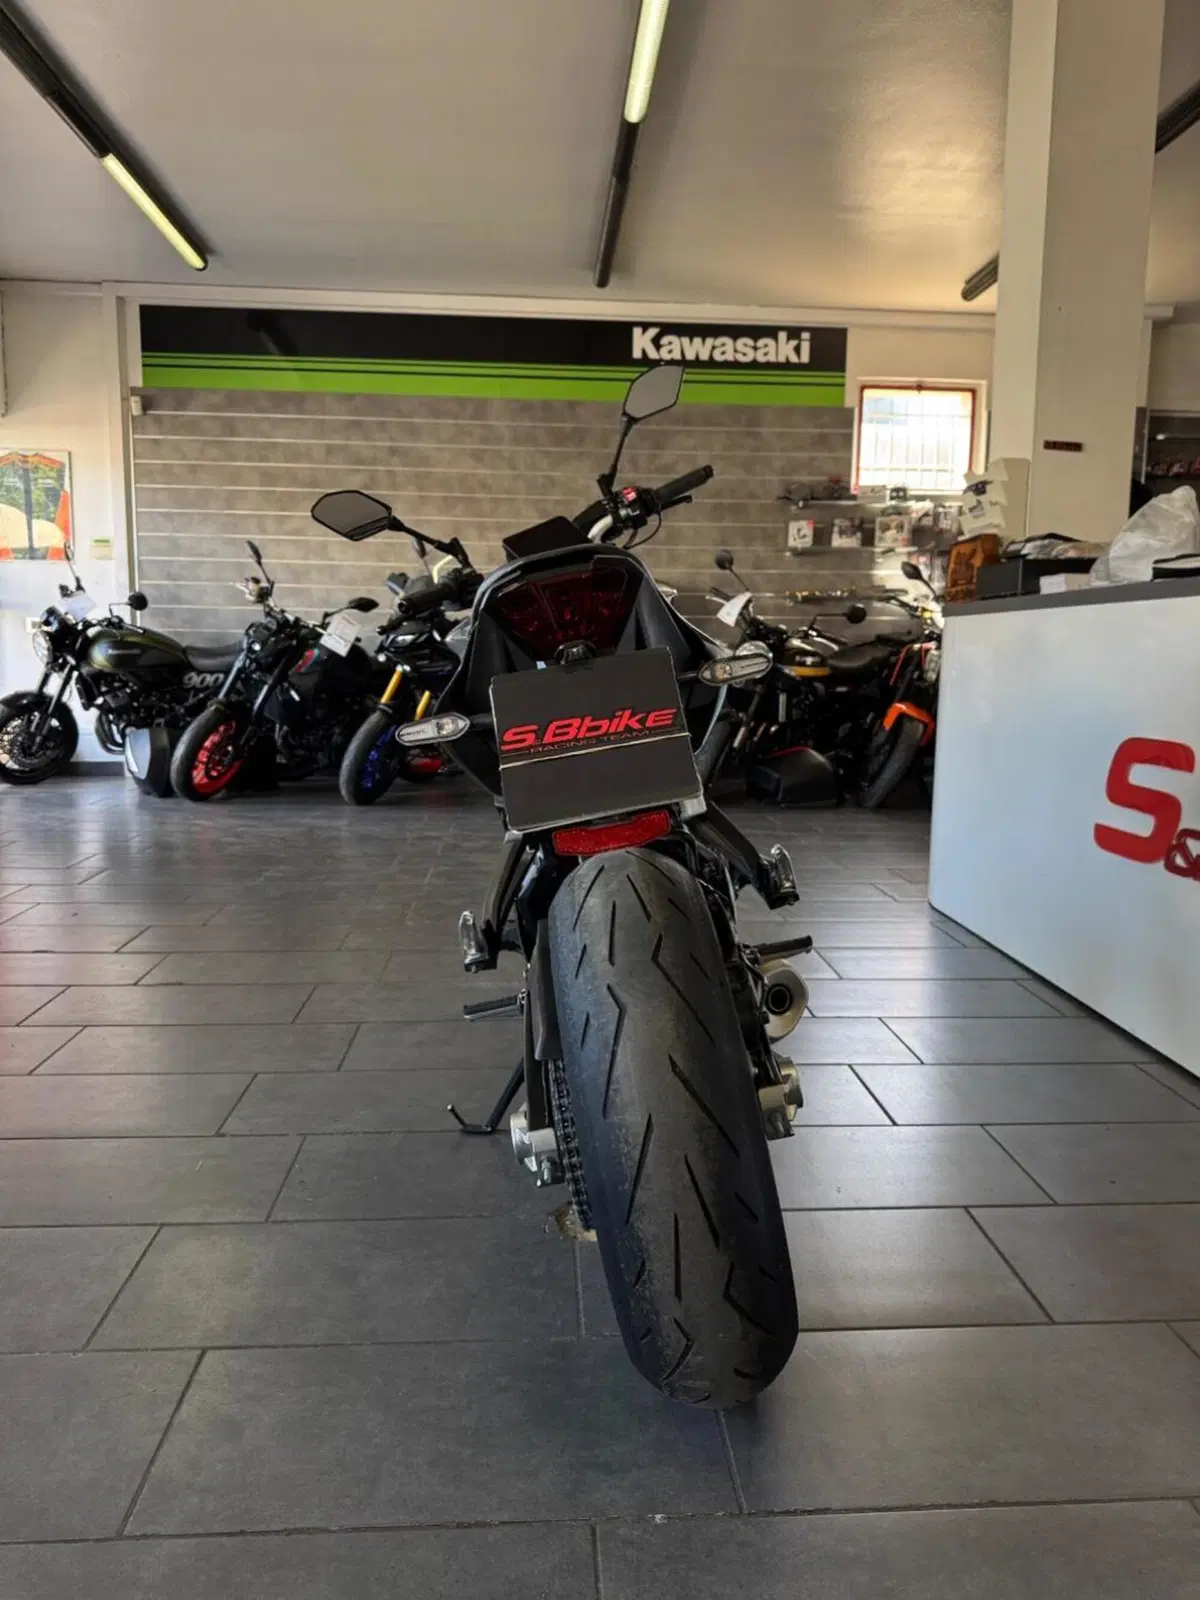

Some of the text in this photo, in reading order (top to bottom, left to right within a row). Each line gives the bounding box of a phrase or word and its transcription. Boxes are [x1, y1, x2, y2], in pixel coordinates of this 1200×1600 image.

[632, 327, 811, 363] Kawasaki
[183, 671, 225, 688] 900
[530, 730, 650, 754] RACING TEAM
